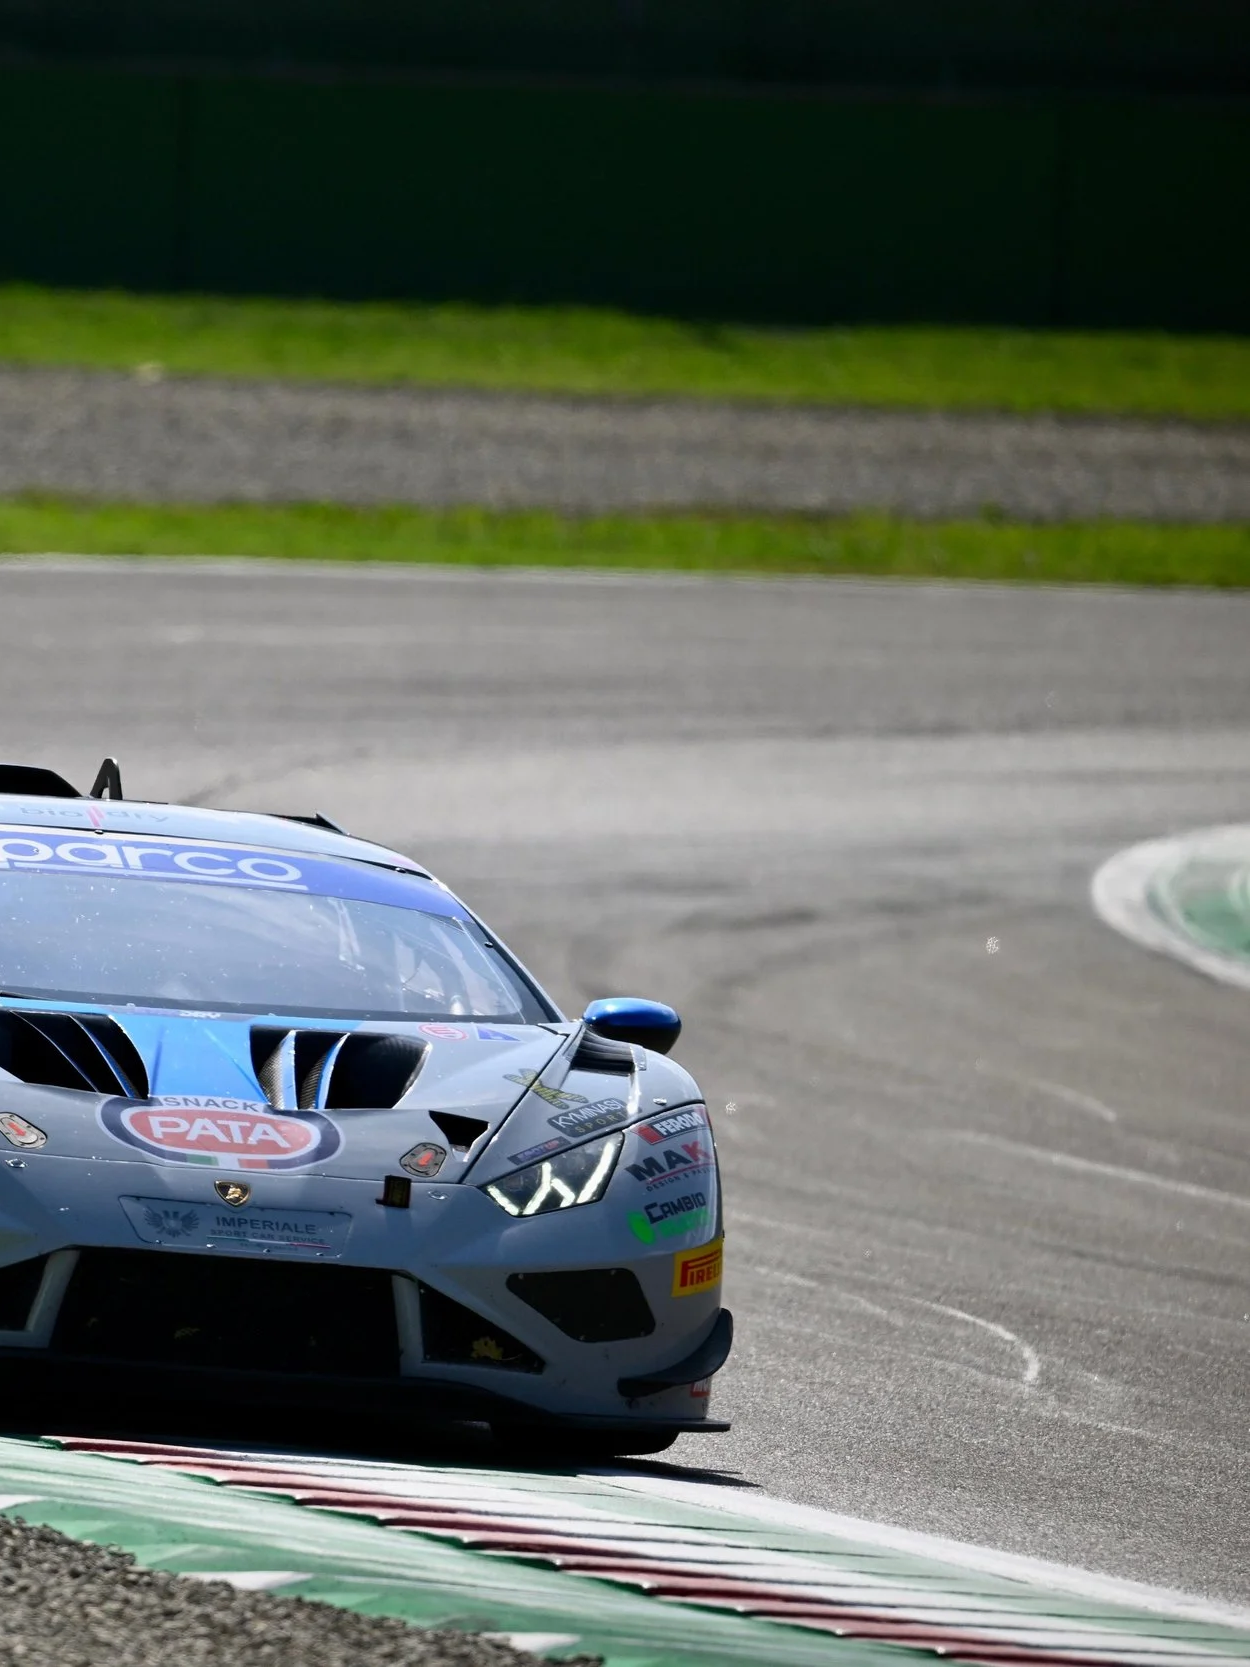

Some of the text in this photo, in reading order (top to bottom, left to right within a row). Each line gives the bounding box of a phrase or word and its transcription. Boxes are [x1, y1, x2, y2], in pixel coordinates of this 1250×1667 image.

[163, 1096, 260, 1113] SNACK
[552, 1099, 624, 1128] KYMINASI
[147, 1115, 292, 1148] PATA
[574, 1111, 628, 1133] SPORT
[653, 1111, 705, 1136] FERODO
[625, 1140, 712, 1181] MAK
[210, 1228, 326, 1244] SPORT CAR SERVICE
[215, 1216, 317, 1235] IMPERIALE
